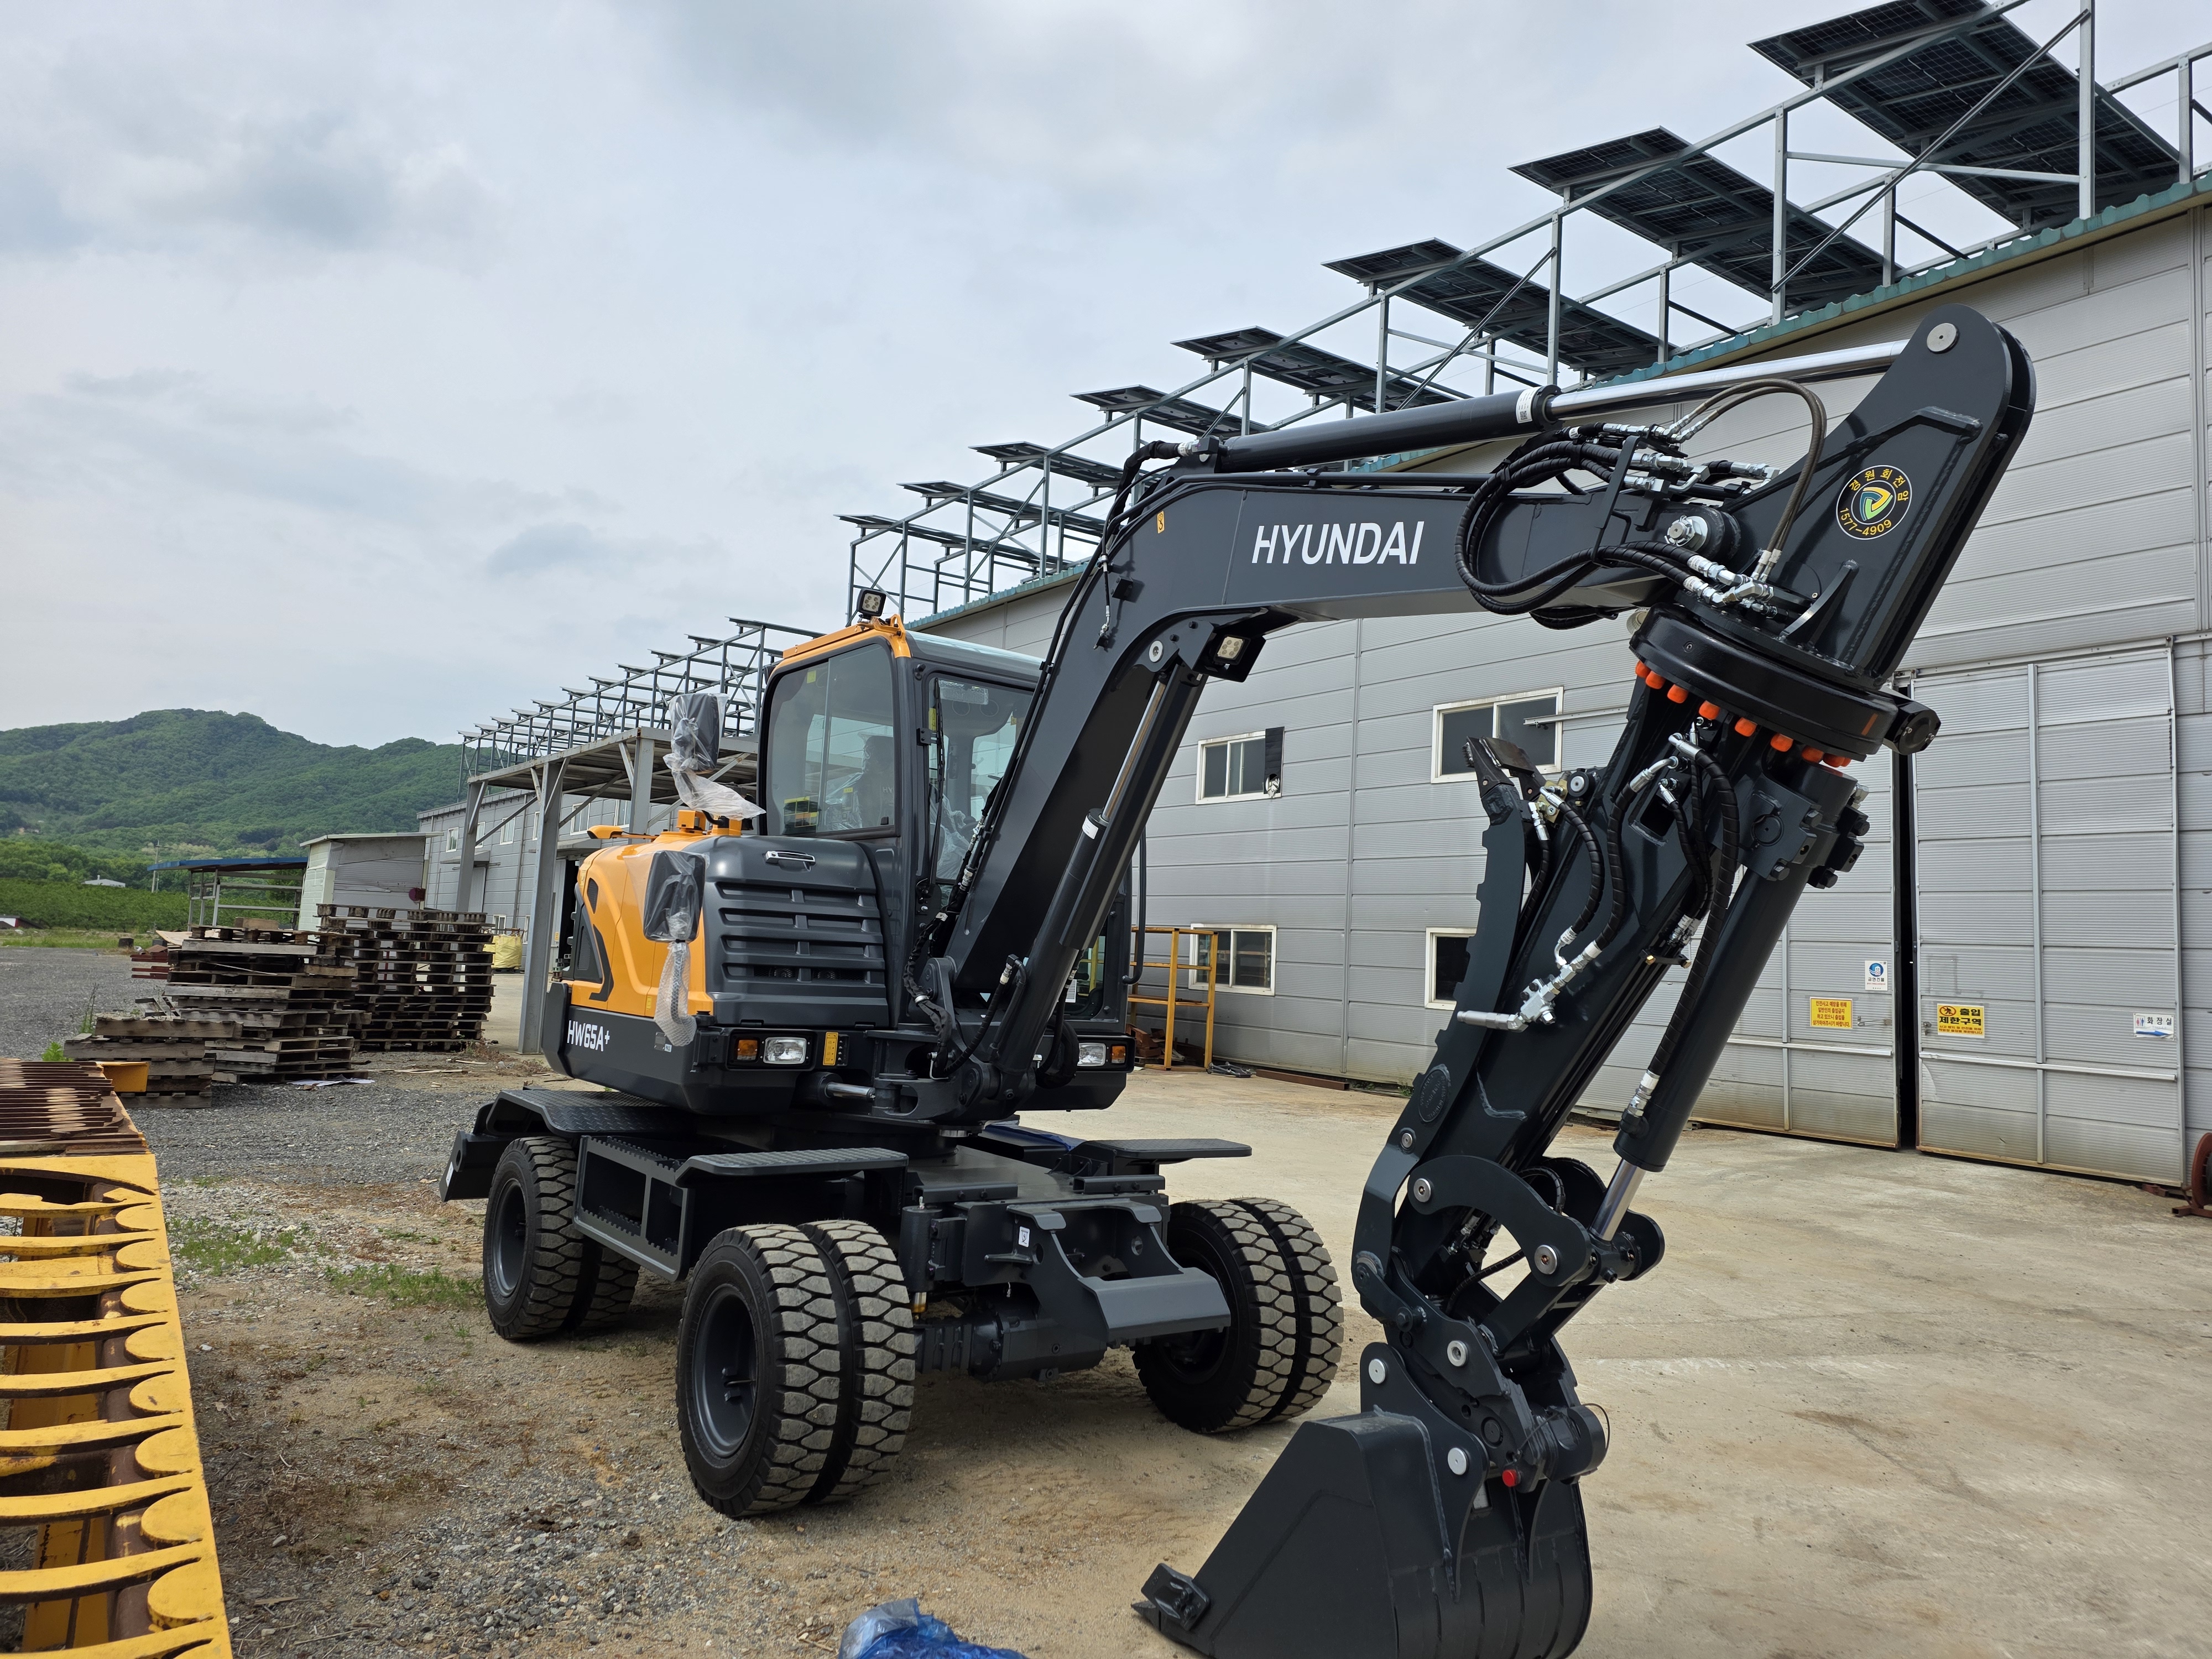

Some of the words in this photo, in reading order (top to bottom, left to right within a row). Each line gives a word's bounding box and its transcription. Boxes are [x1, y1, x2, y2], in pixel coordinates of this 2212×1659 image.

[1840, 508, 1892, 536] 1577-4909
[1252, 521, 1425, 565] HYUNDAI
[1939, 1016, 1981, 1026] 제한구역
[1960, 1008, 1981, 1016] 출입
[2147, 1016, 2172, 1025] 화장실
[567, 1020, 610, 1052] HW65A+
